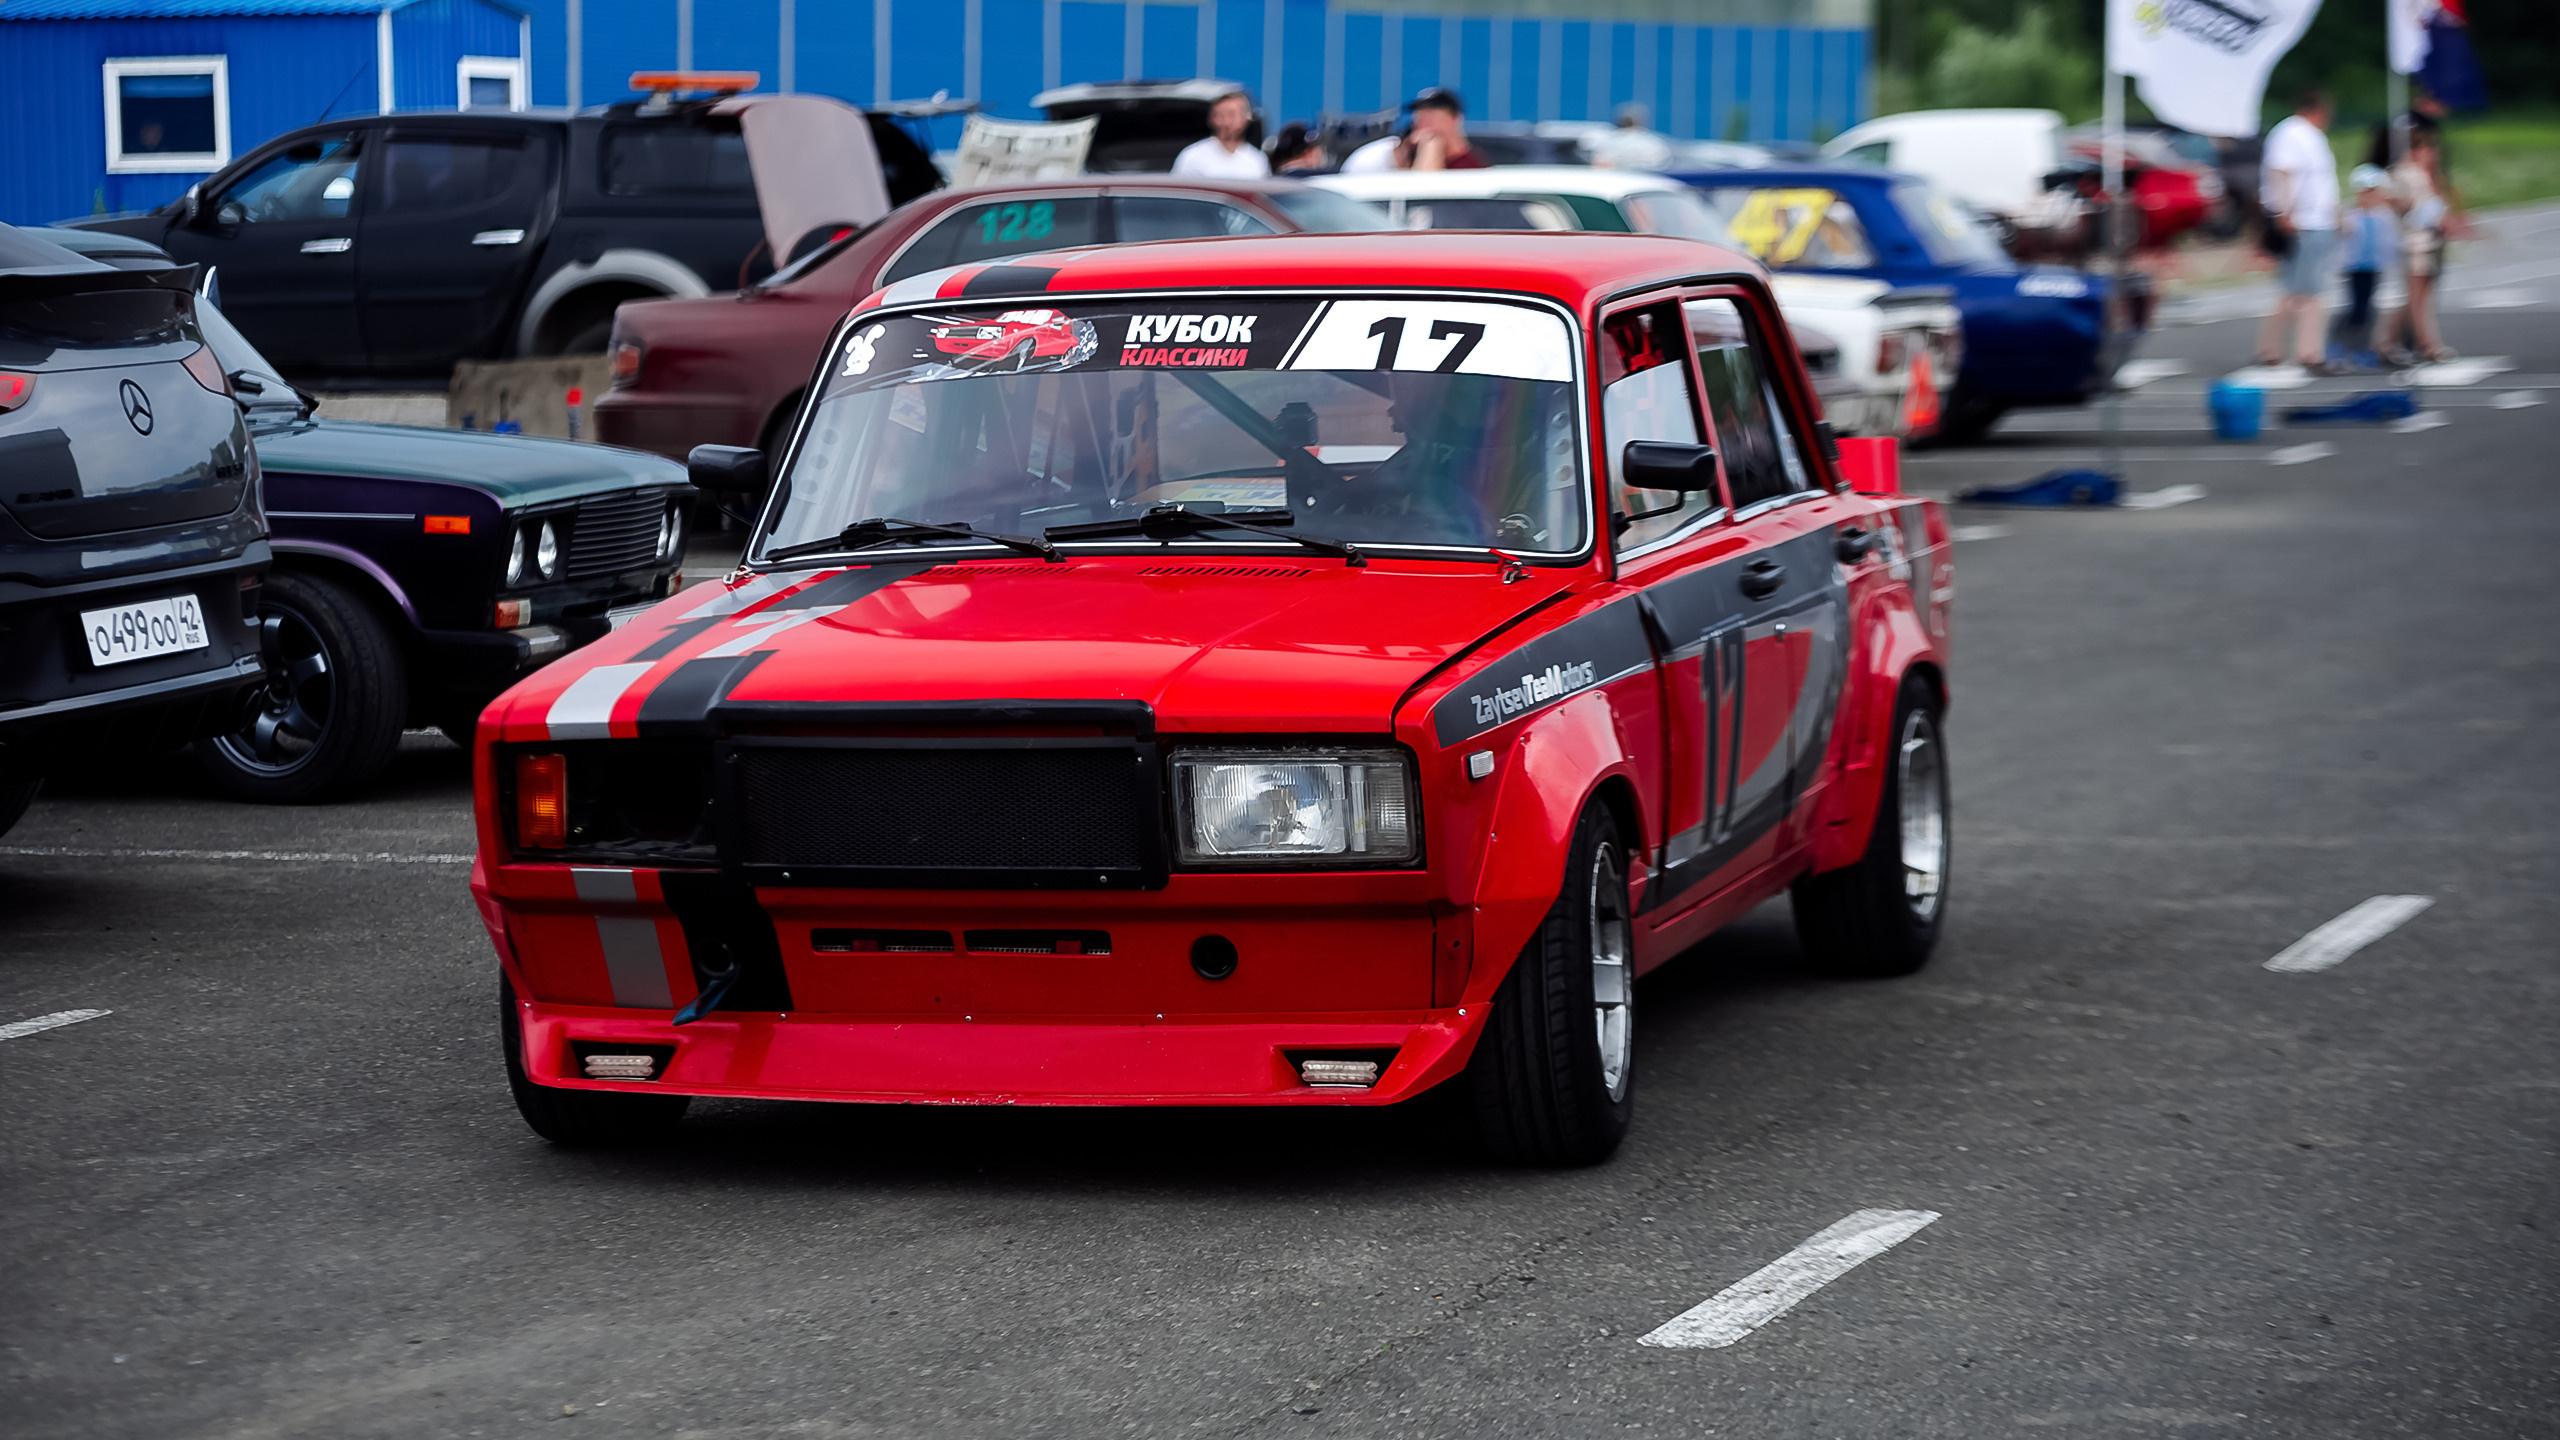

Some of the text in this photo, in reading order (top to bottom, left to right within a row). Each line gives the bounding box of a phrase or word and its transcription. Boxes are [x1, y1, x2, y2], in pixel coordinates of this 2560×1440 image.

[977, 202, 1054, 245] 128
[1126, 314, 1258, 343] КУБОК
[1119, 348, 1249, 367] КЛАССИКИ
[1367, 316, 1487, 373] 17
[179, 600, 199, 631] 42
[185, 632, 200, 645] RUS
